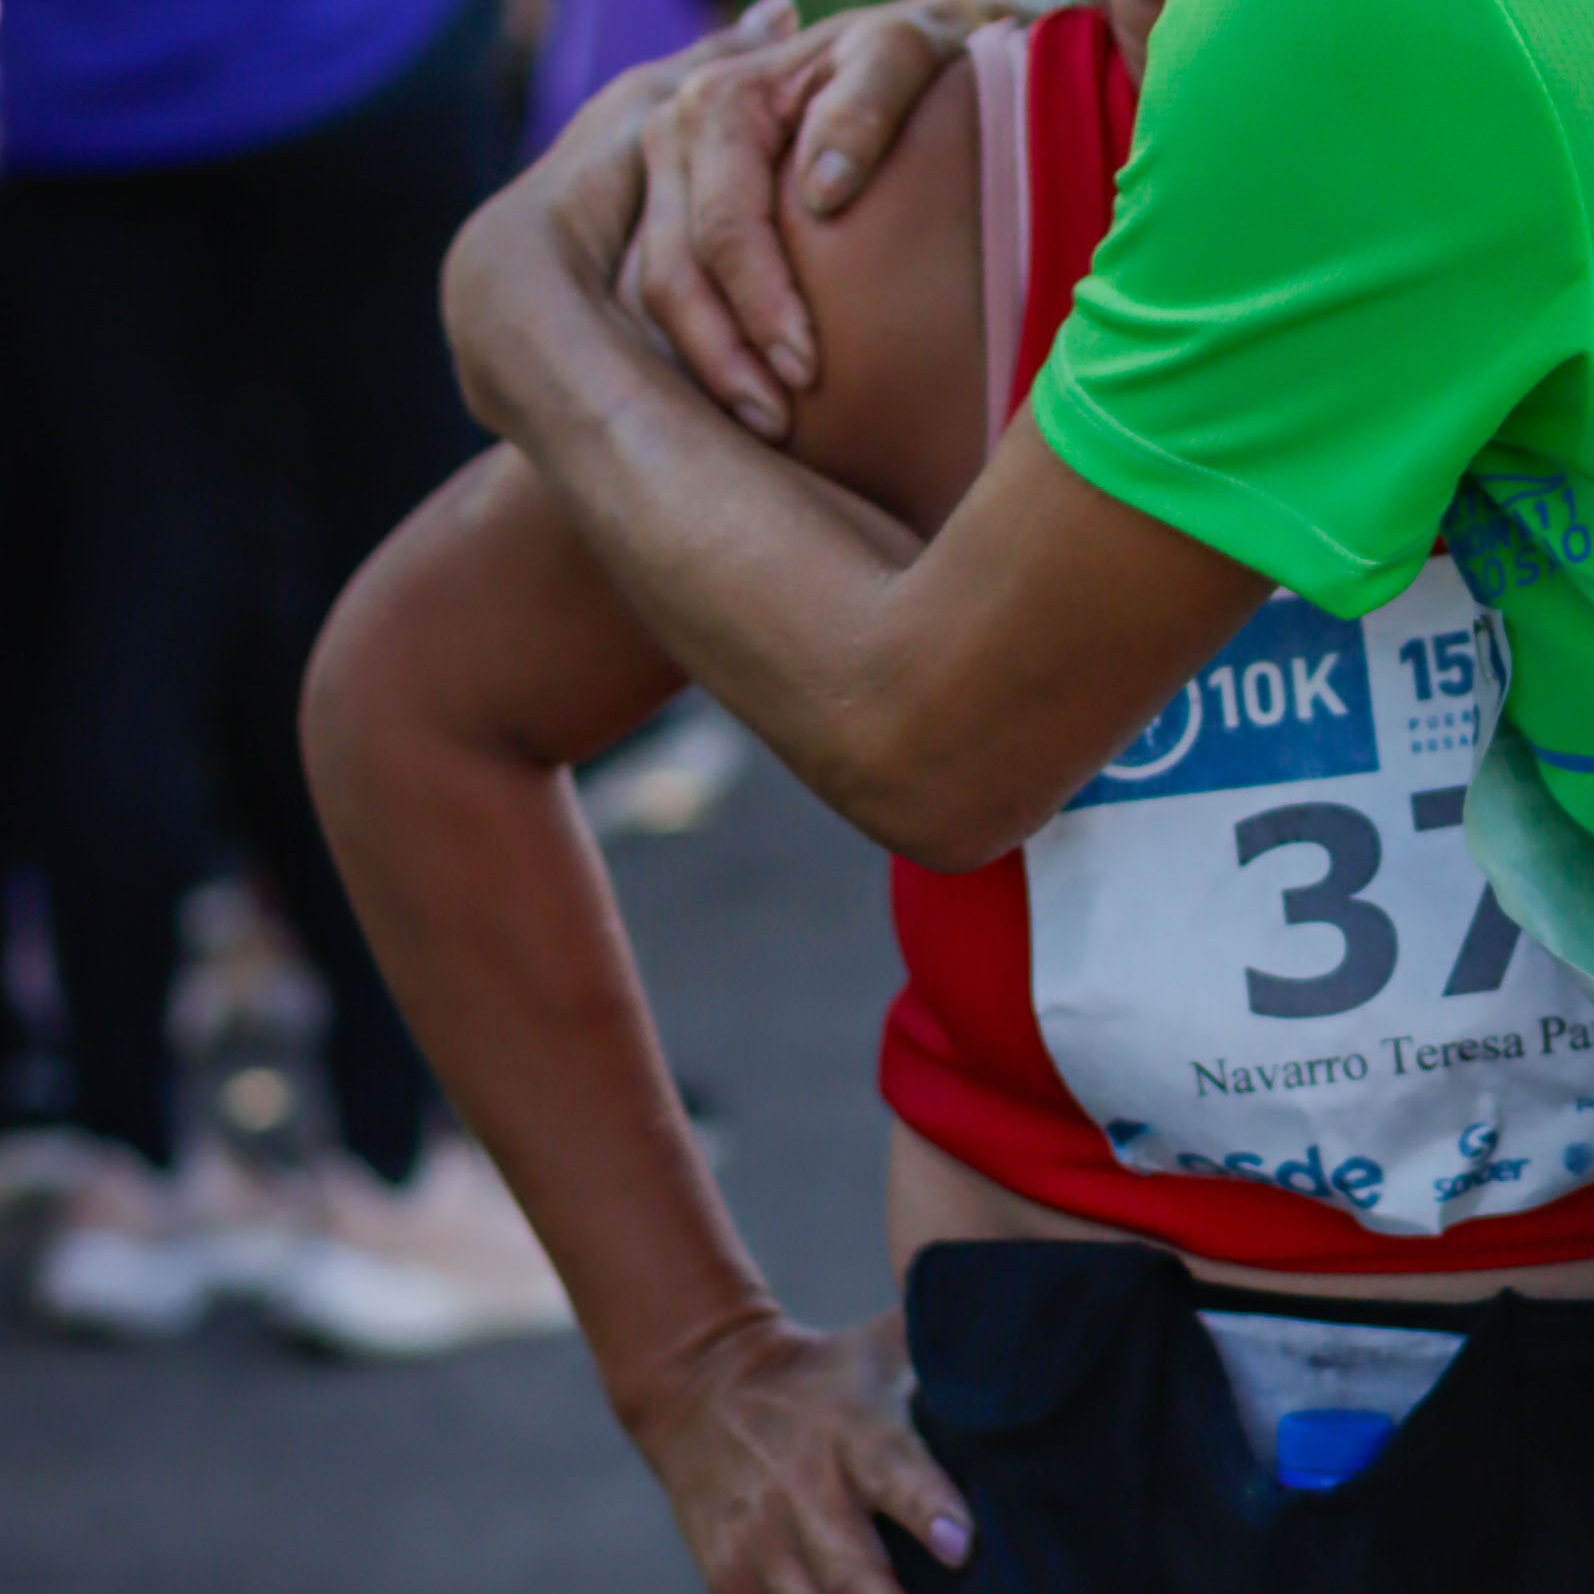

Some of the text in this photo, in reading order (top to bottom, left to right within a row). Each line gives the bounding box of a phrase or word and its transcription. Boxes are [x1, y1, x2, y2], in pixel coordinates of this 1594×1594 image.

[1206, 651, 1350, 733] 10K
[1234, 785, 1522, 1019] 37
[1189, 1051, 1369, 1097] Navarro
[1380, 1031, 1526, 1076] Teresa
